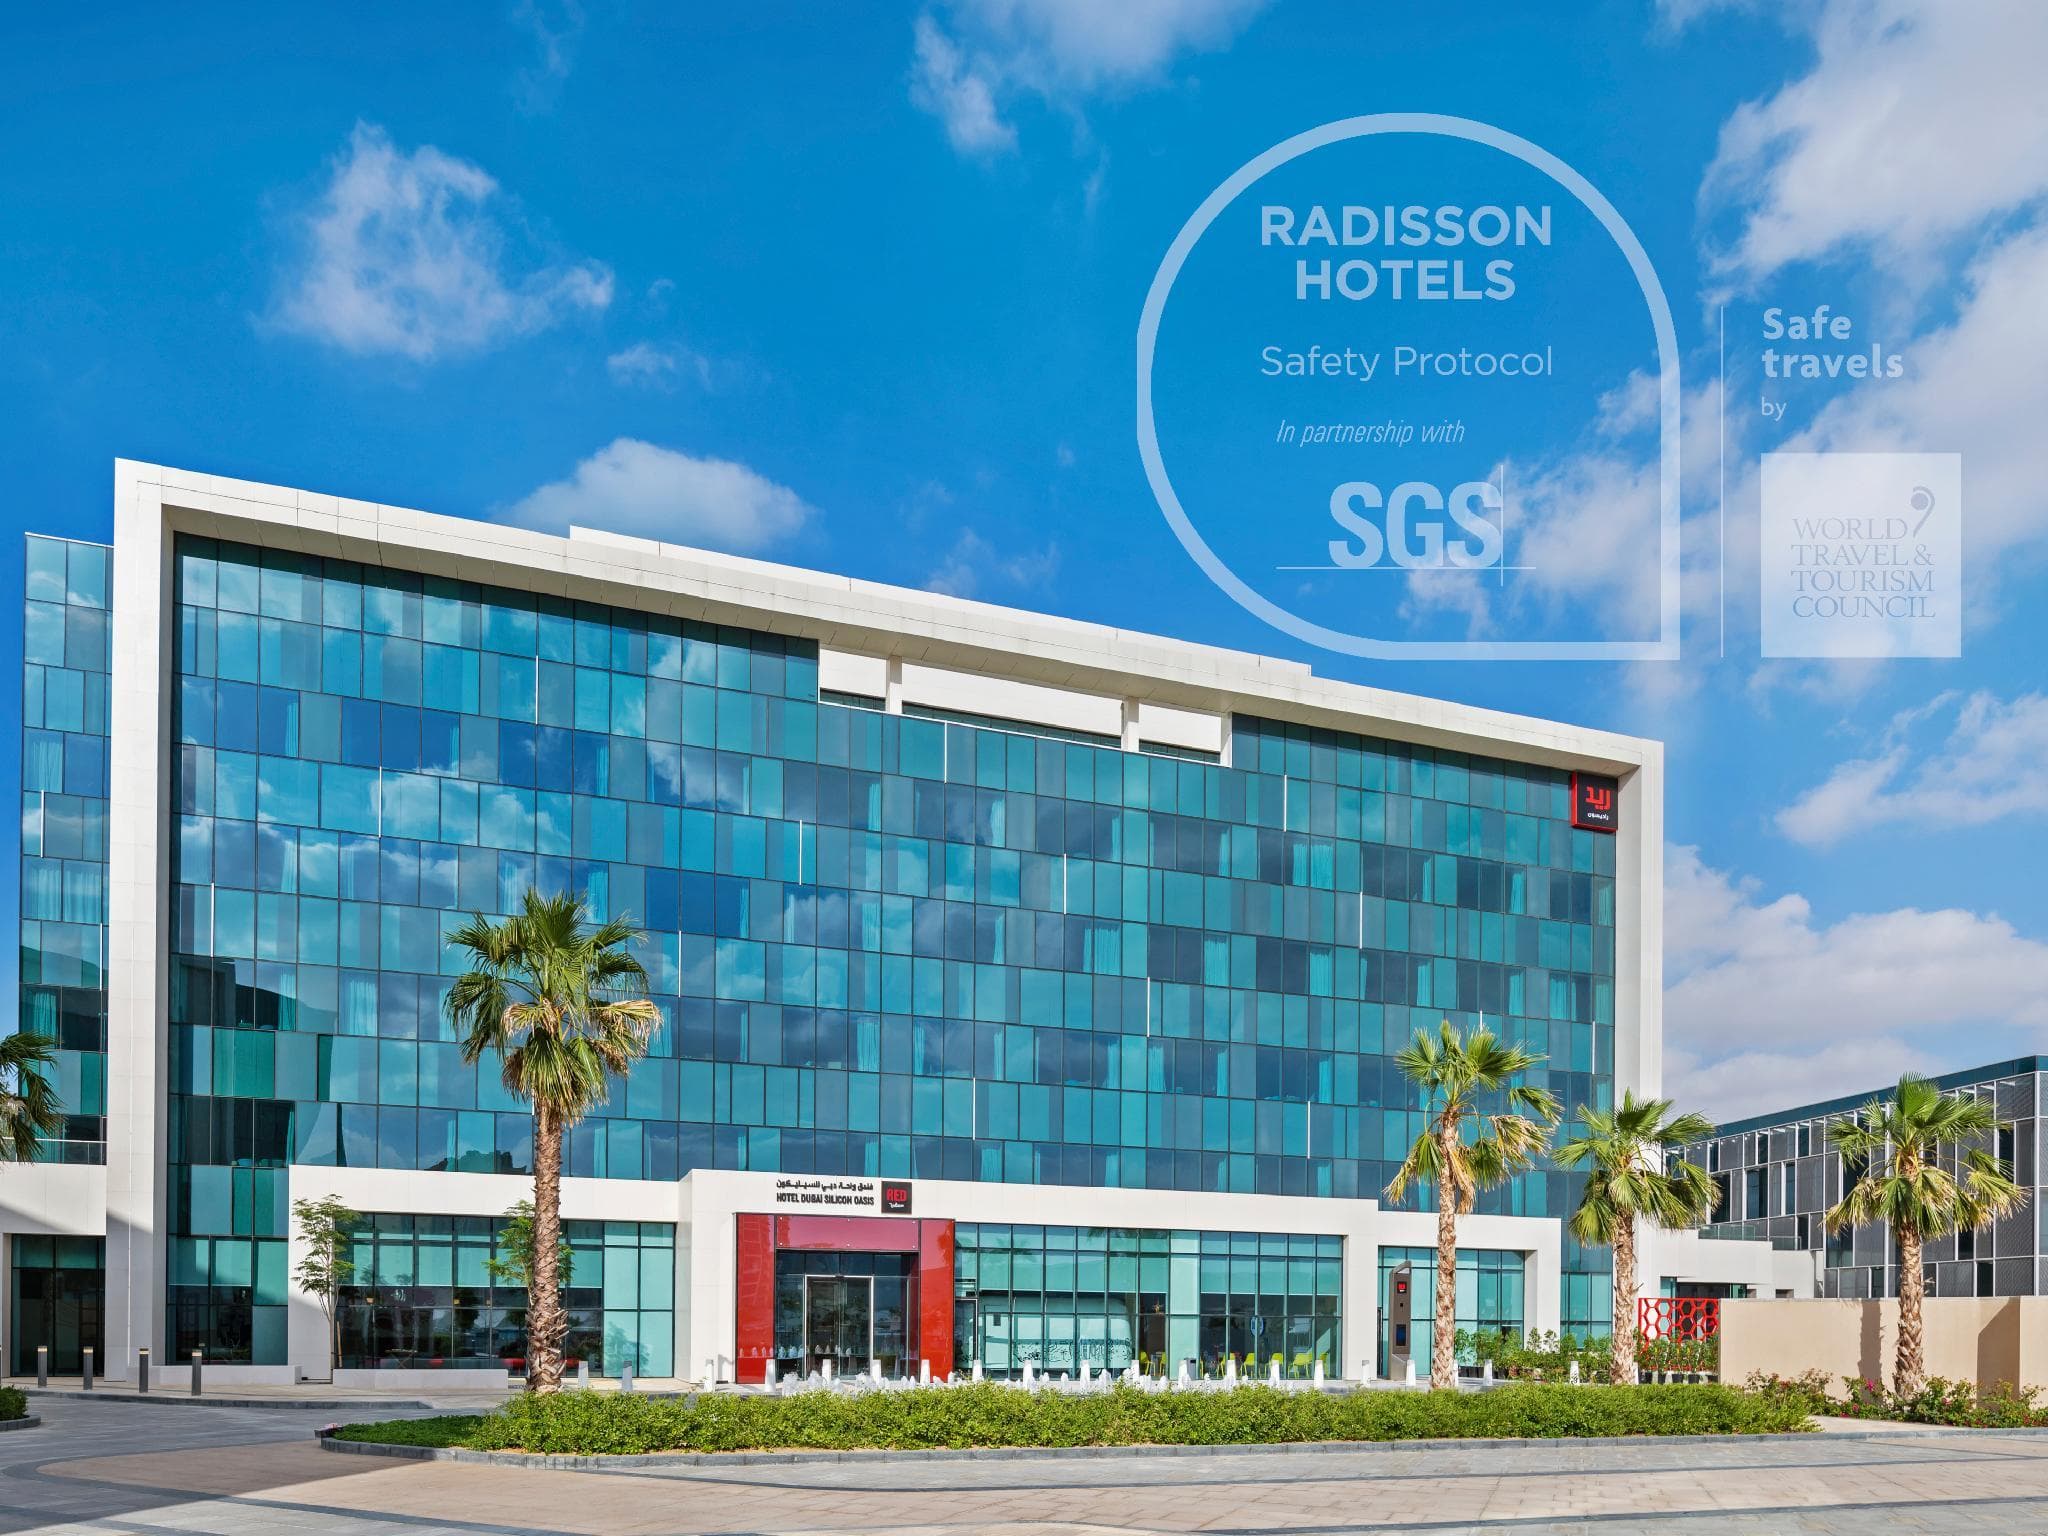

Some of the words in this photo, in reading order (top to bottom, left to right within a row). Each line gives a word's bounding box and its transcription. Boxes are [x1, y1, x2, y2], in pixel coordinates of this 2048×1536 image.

[821, 1183, 838, 1192] دبي
[776, 1192, 799, 1203] HOTEL
[800, 1193, 823, 1204] DUBAI
[824, 1194, 853, 1205] SILICON
[854, 1196, 875, 1206] OASIS
[886, 1188, 907, 1202] RED
